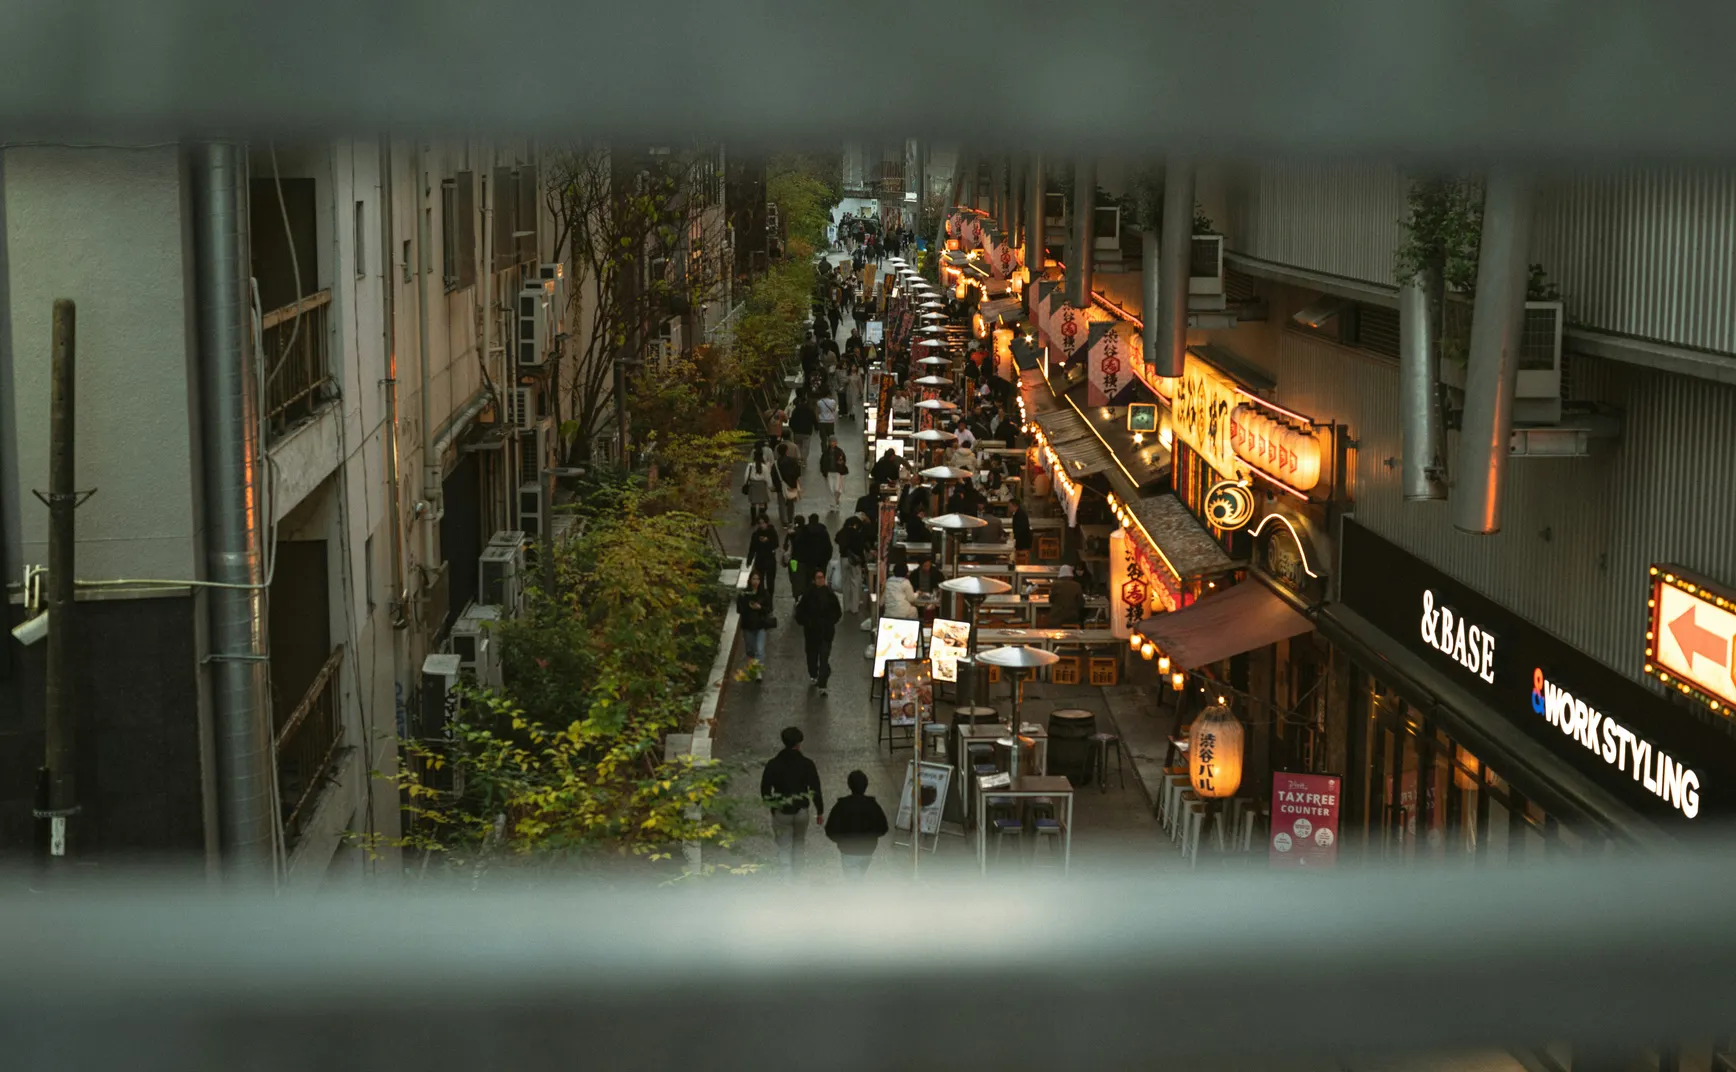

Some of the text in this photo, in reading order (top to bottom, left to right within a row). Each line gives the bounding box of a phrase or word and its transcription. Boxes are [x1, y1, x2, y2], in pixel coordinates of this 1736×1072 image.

[1421, 589, 1495, 684] &BASE
[1199, 732, 1216, 792] 渋谷バル
[1602, 716, 1700, 819] STYLING
[1280, 804, 1330, 816] COUNTER
